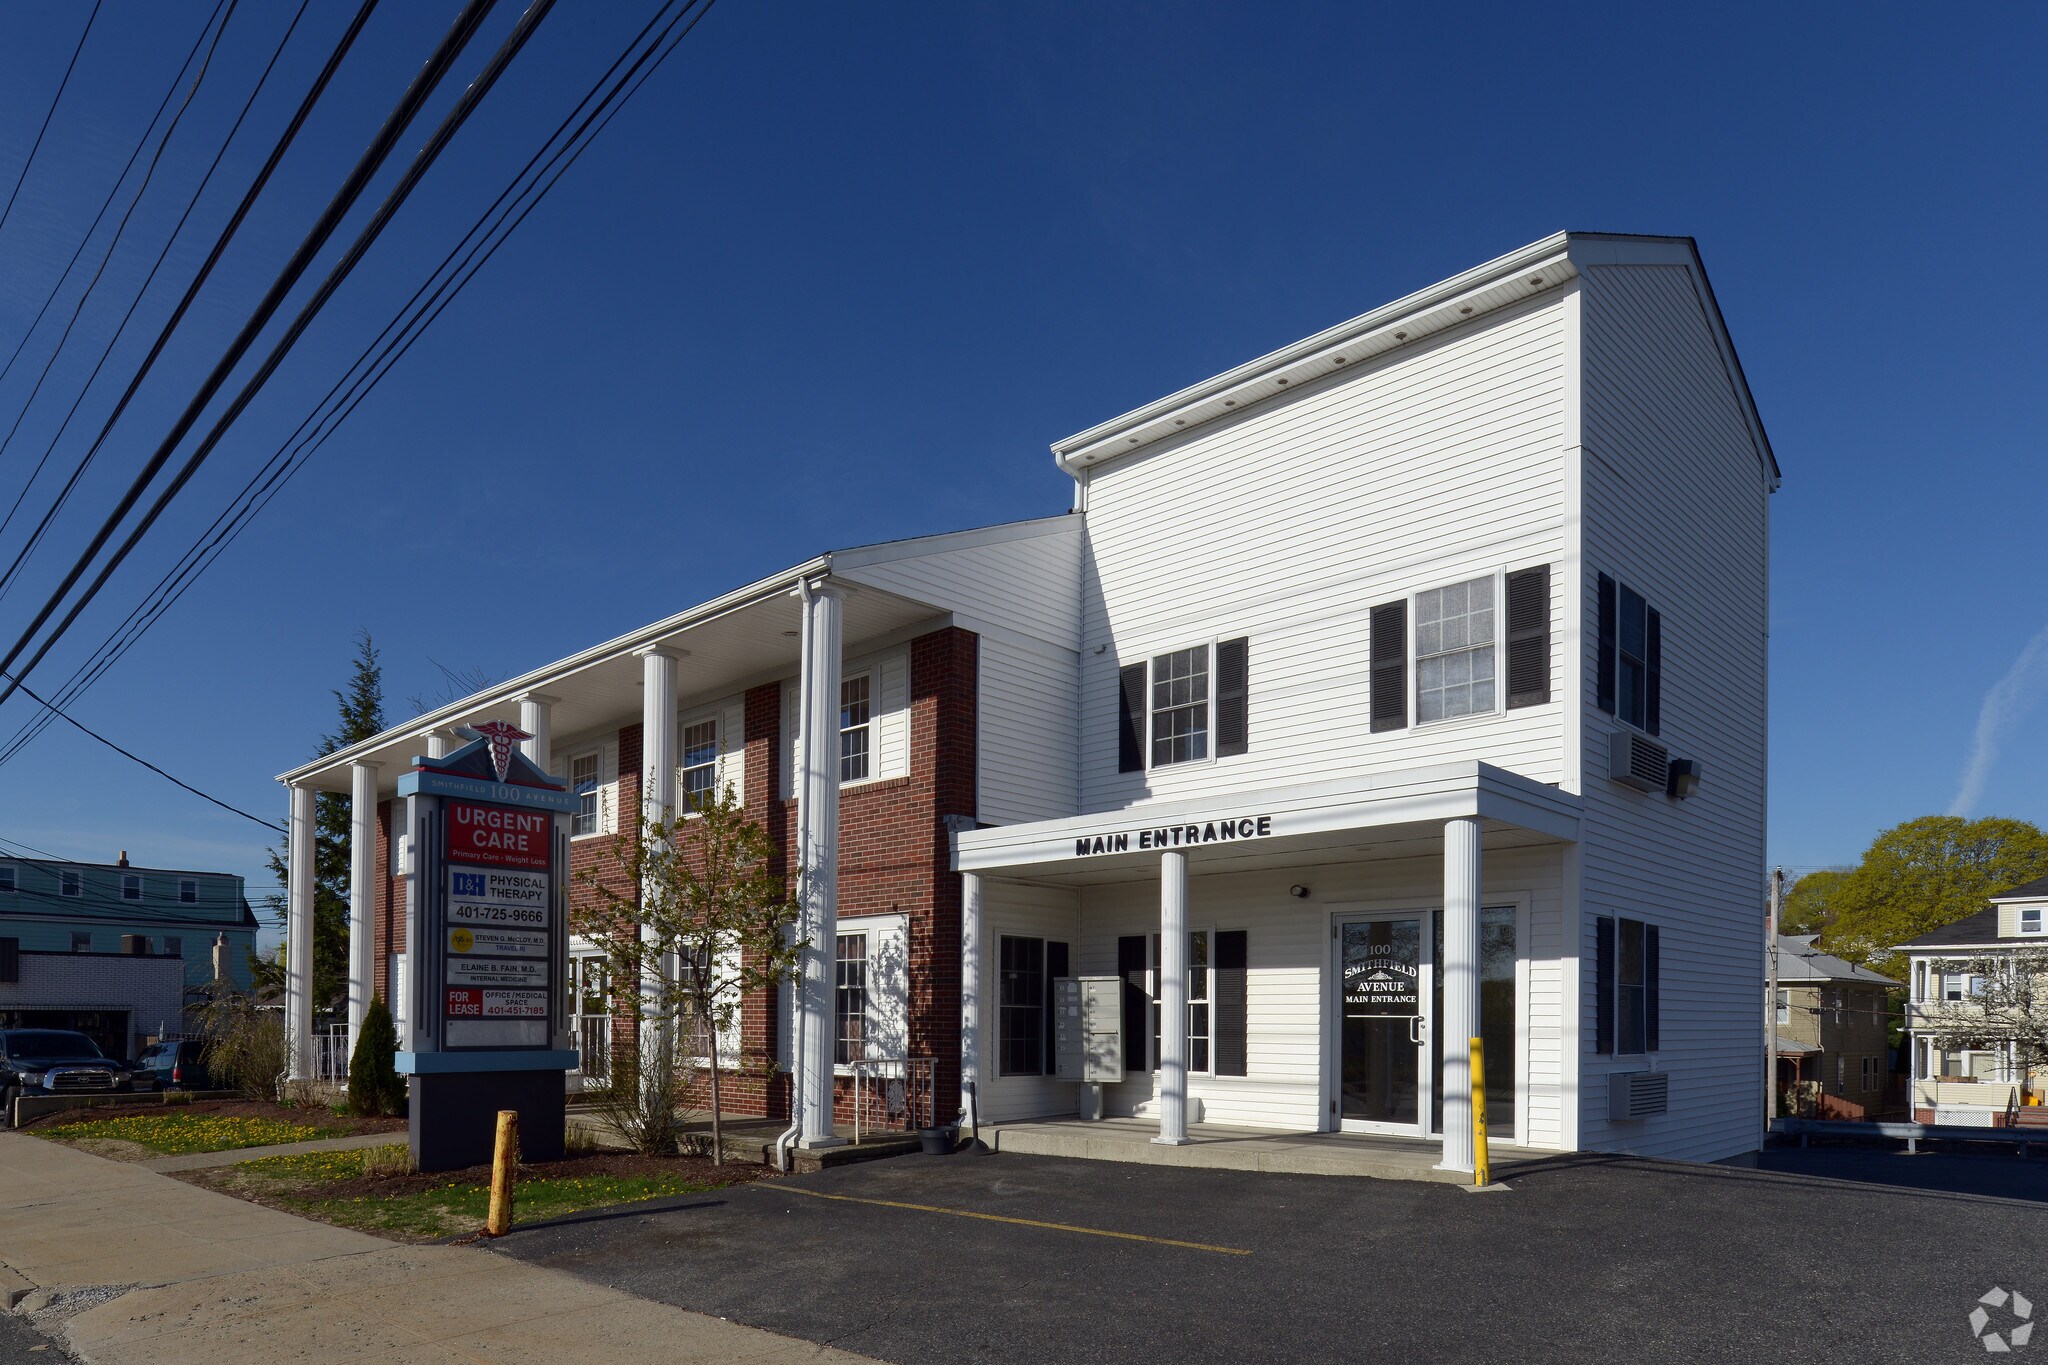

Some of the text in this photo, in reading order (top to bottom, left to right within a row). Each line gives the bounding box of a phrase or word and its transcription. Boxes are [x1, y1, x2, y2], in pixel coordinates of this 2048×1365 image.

[431, 780, 569, 805] SMITHFIELD 100 AVENUE
[457, 806, 544, 833] URGENT
[472, 829, 528, 851] CARE
[1075, 816, 1272, 856] MAIN ENTRANCE
[452, 849, 481, 861] Primary
[482, 852, 499, 861] Care
[505, 855, 529, 866] Weight
[530, 857, 546, 865] Loss
[453, 872, 486, 896] D&H
[490, 875, 545, 889] PHYSICAL
[490, 887, 542, 900] THERAPY
[456, 906, 543, 922] 401-725-9666
[1370, 944, 1391, 955] 100
[461, 963, 489, 972] ELAINE
[1344, 959, 1417, 979] SMITHFIELD
[1357, 982, 1405, 992] AVENUE
[449, 991, 469, 1002] FOR
[1345, 995, 1417, 1003] MAIN ENTRANCE
[449, 1003, 480, 1015] LEASE
[488, 1006, 545, 1015] 401-451-7185
